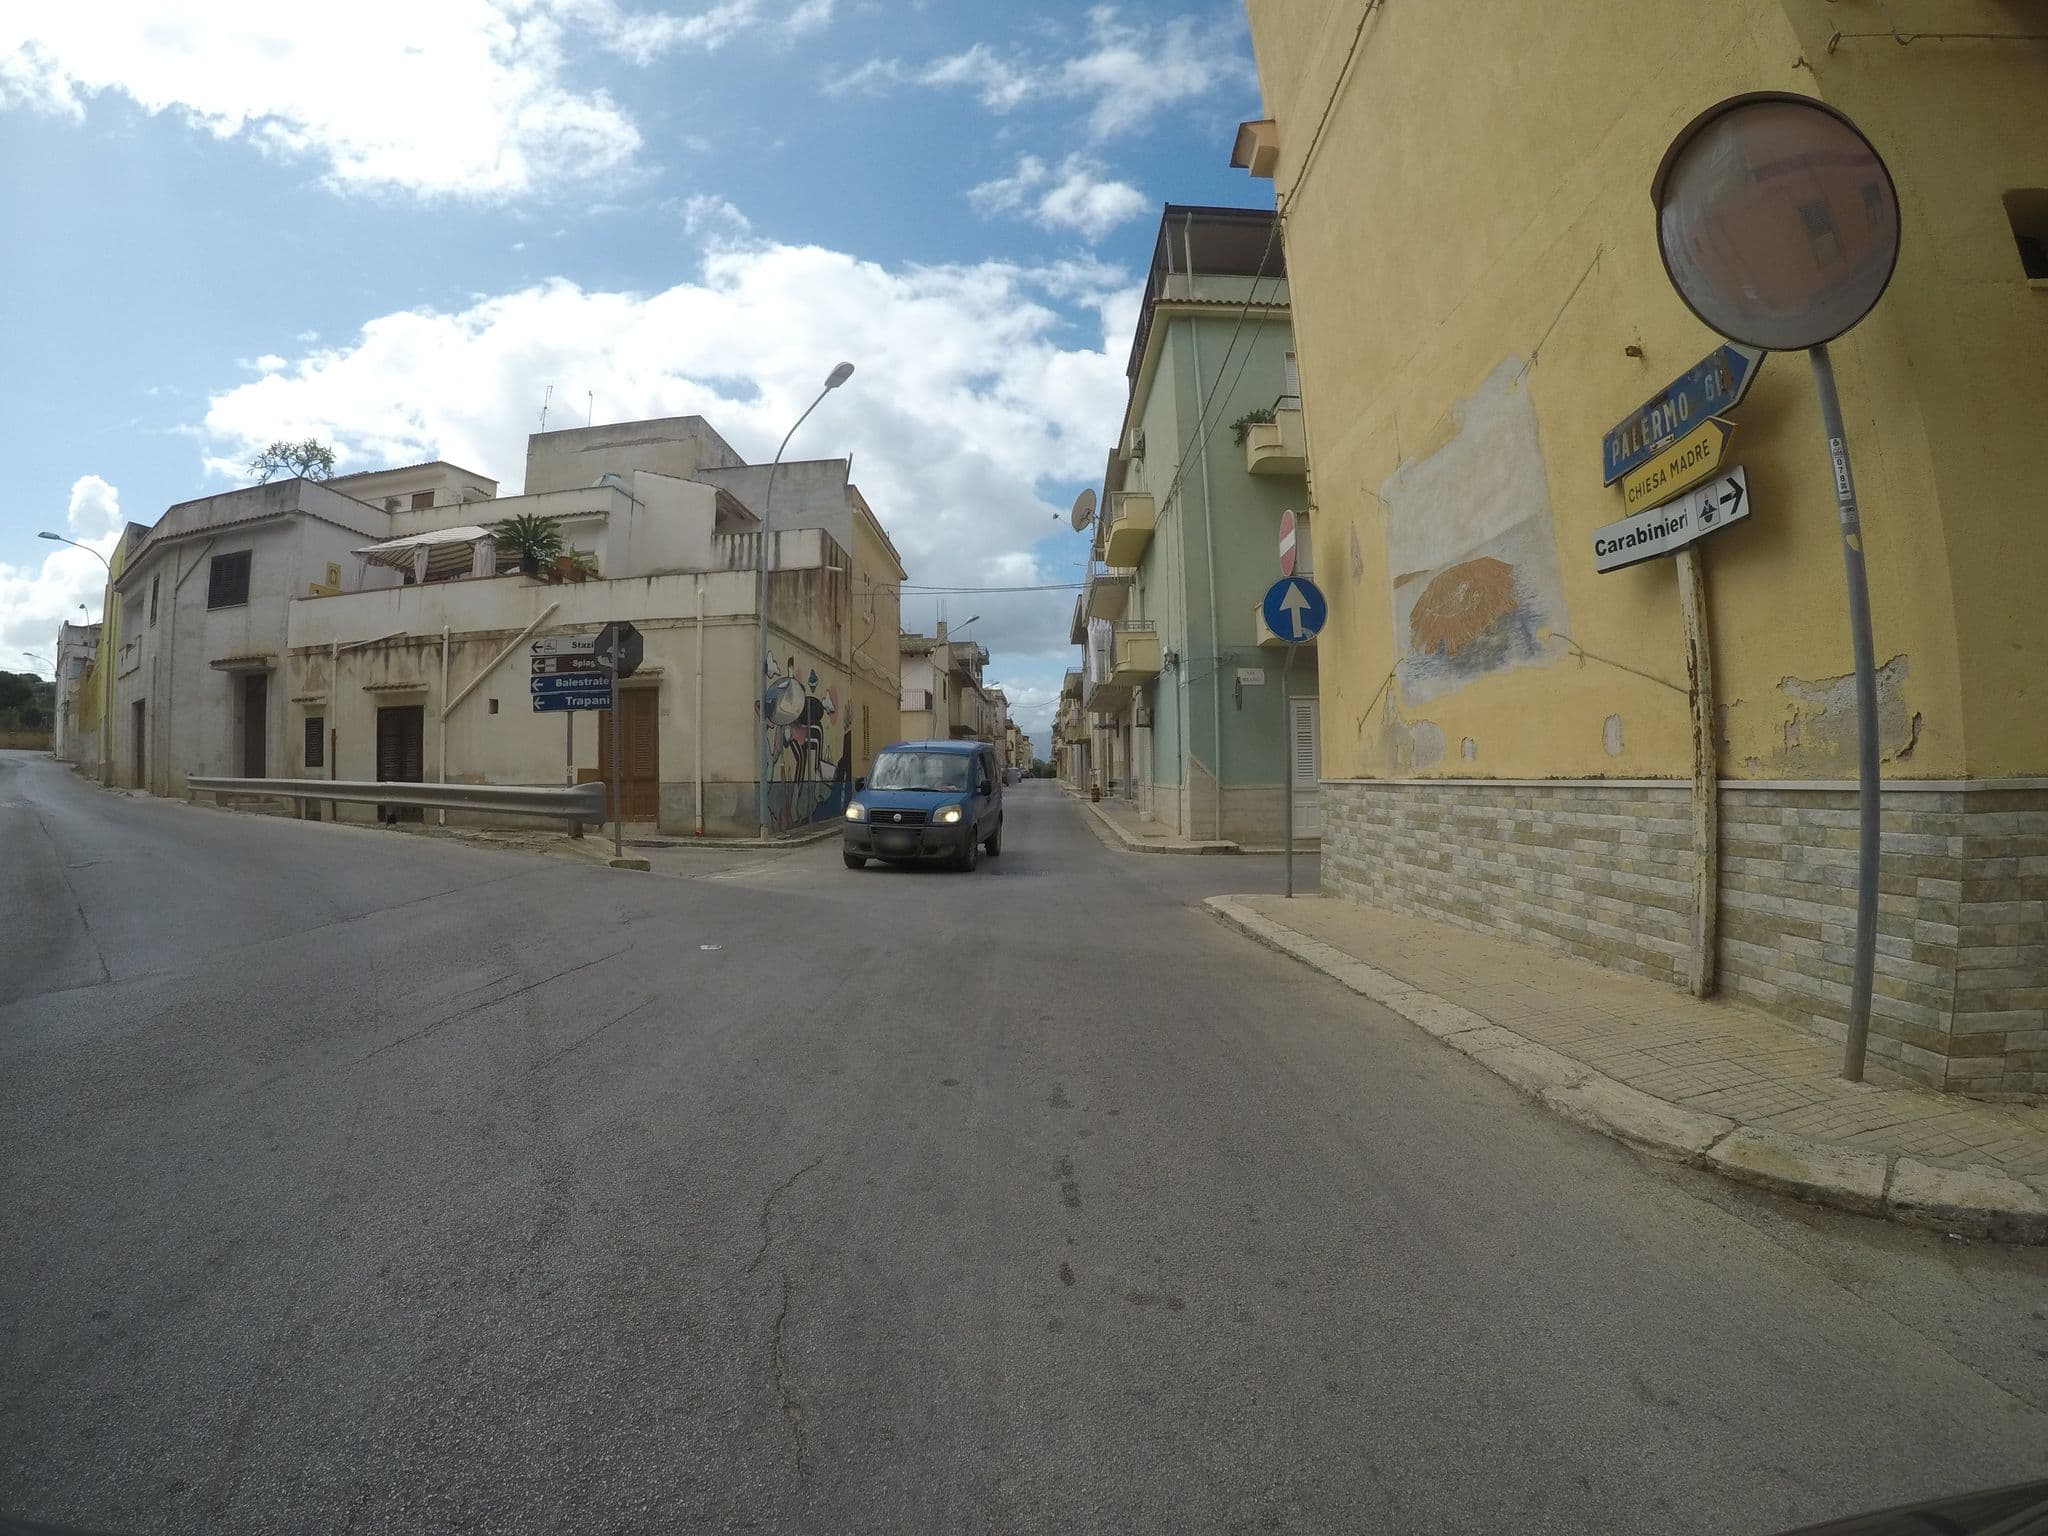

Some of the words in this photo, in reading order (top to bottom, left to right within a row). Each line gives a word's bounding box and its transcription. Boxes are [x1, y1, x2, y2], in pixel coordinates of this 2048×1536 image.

[1612, 391, 1689, 466] PALERMO
[1628, 469, 1667, 503] CHIESA
[1669, 439, 1711, 480] MADRE
[1594, 508, 1688, 557] Carabinieri
[555, 678, 610, 688] Balestrate
[565, 696, 610, 707] Trapani
